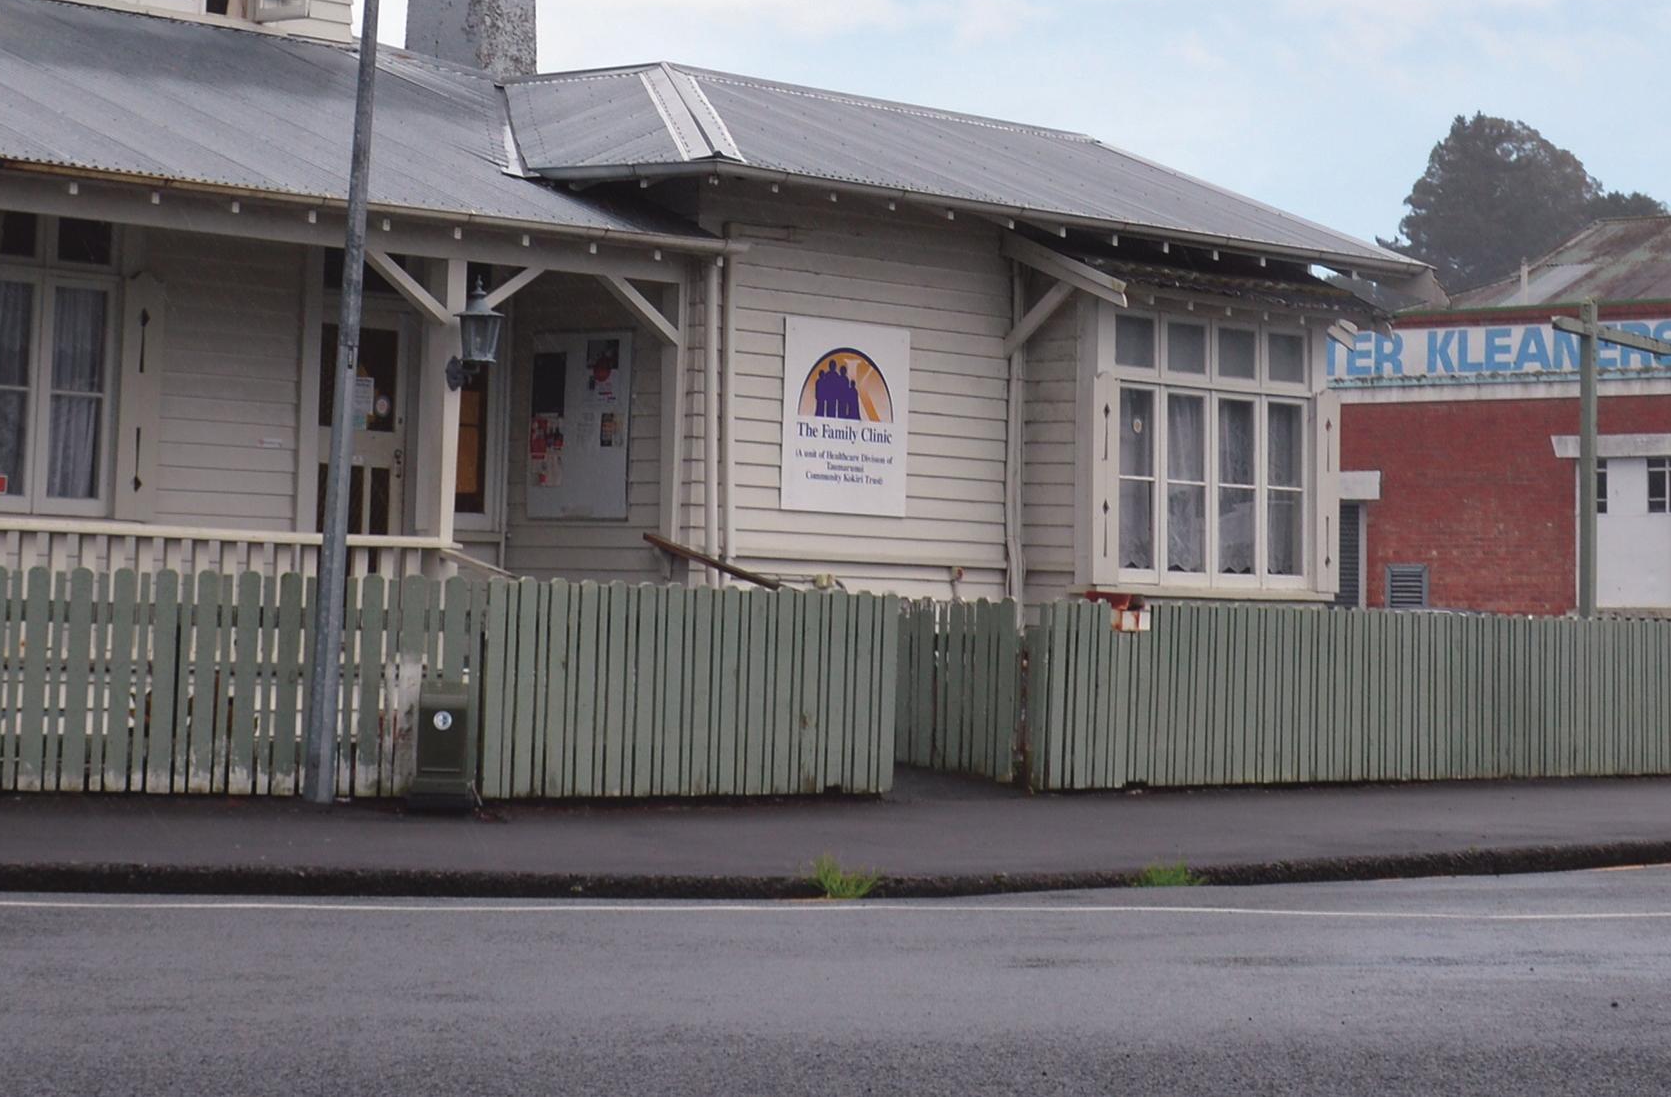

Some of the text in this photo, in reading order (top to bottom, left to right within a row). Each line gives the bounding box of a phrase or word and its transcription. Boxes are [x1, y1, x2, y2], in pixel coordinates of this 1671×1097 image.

[797, 422, 893, 444] The Family Clinic
